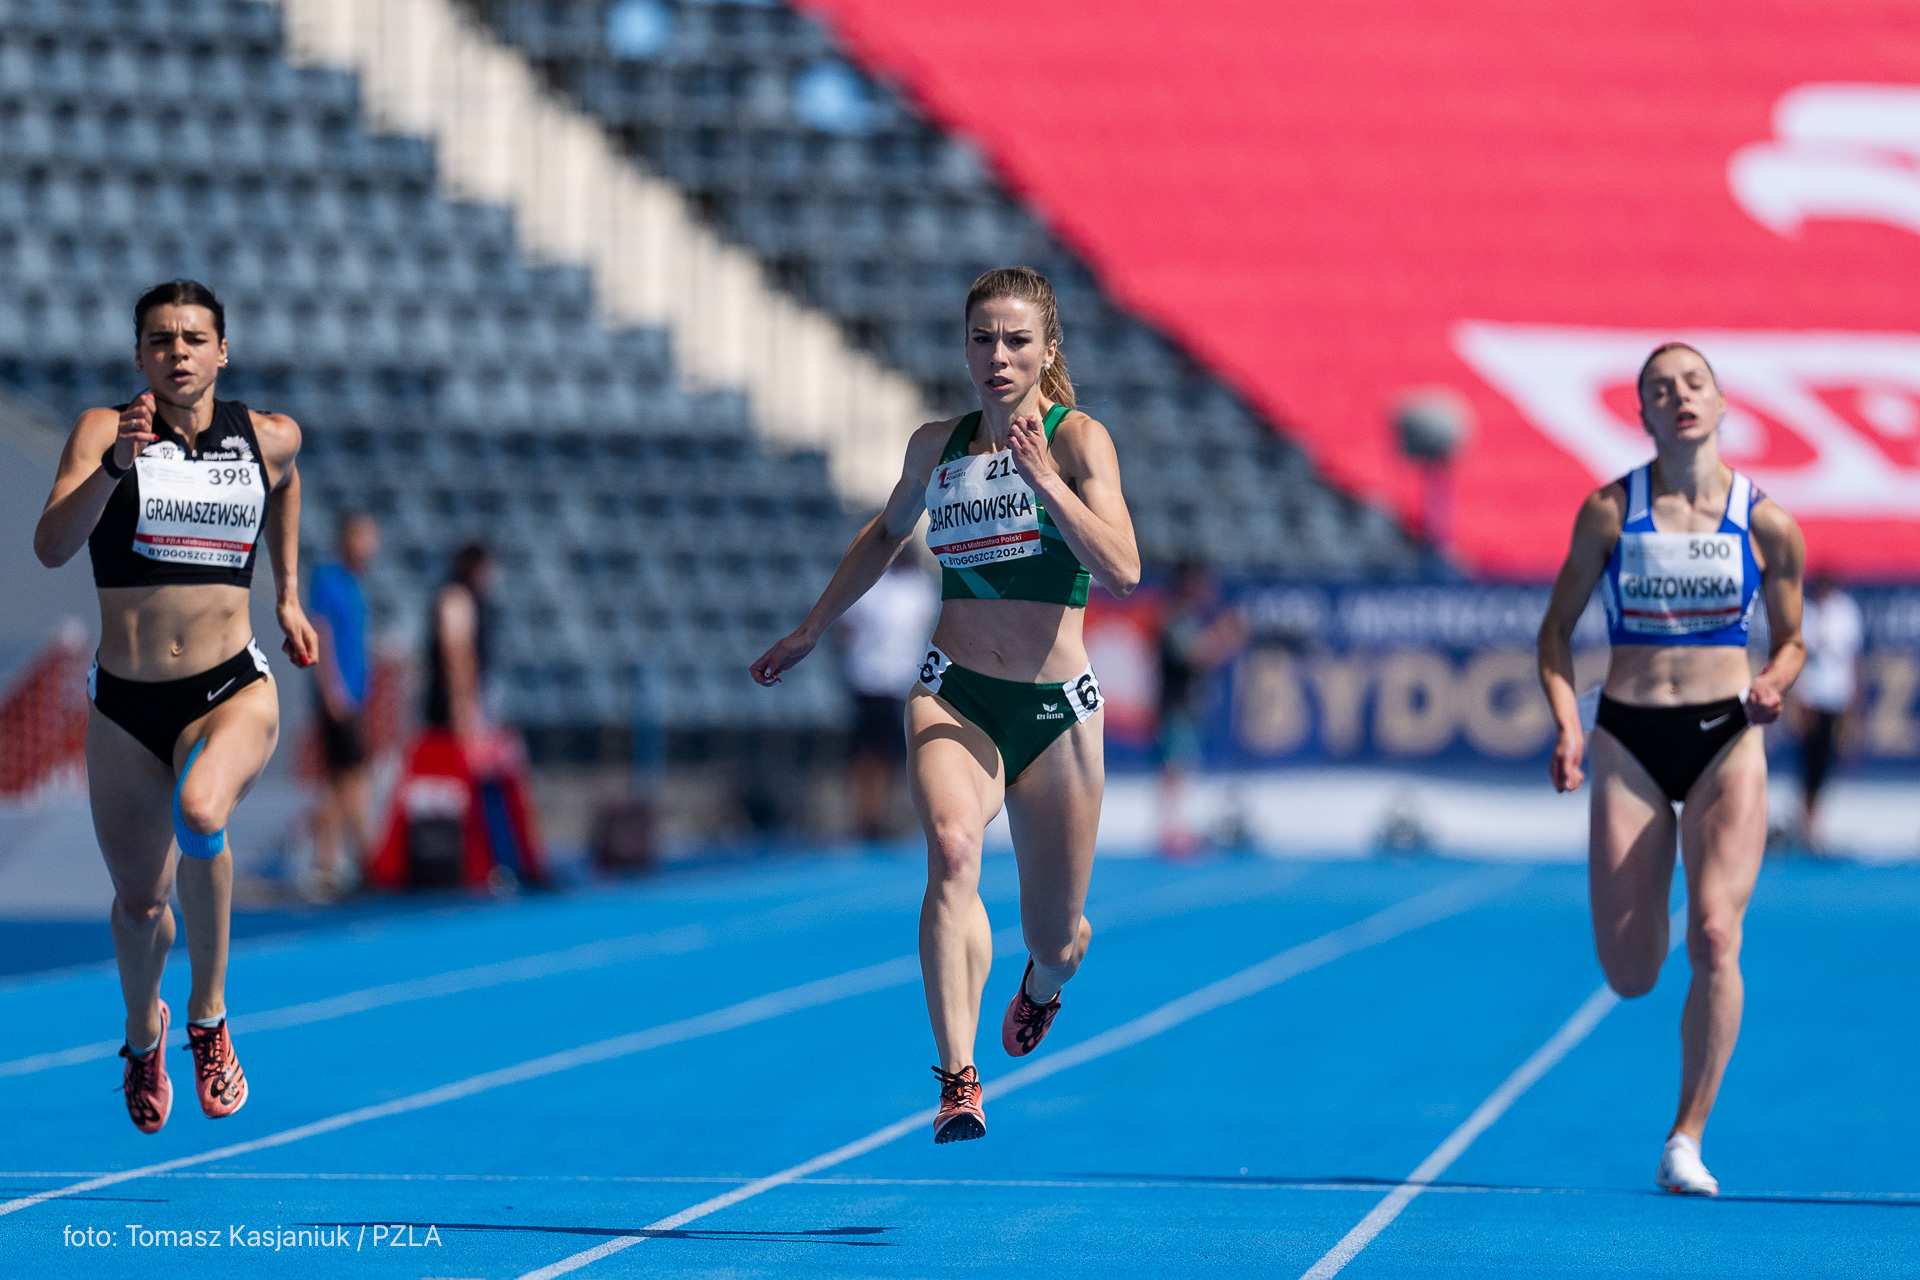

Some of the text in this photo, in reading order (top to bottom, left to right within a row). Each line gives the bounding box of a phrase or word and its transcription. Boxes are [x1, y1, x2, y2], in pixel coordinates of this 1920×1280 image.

[208, 468, 252, 485] 398
[145, 498, 257, 528] GRANASZEWSKA
[931, 492, 1032, 533] BARTNOWSKA
[952, 544, 967, 552] PZLA
[968, 538, 1000, 549] Mistrzostwa
[1001, 534, 1022, 543] Polski
[1688, 540, 1731, 560] 500
[148, 547, 242, 563] BYDGOSZCZ 2024
[948, 546, 1025, 565] BYDGOSZCZ 2024
[1624, 577, 1737, 599] GUZOWSKA
[1075, 673, 1099, 711] 6
[1036, 711, 1065, 721] erima
